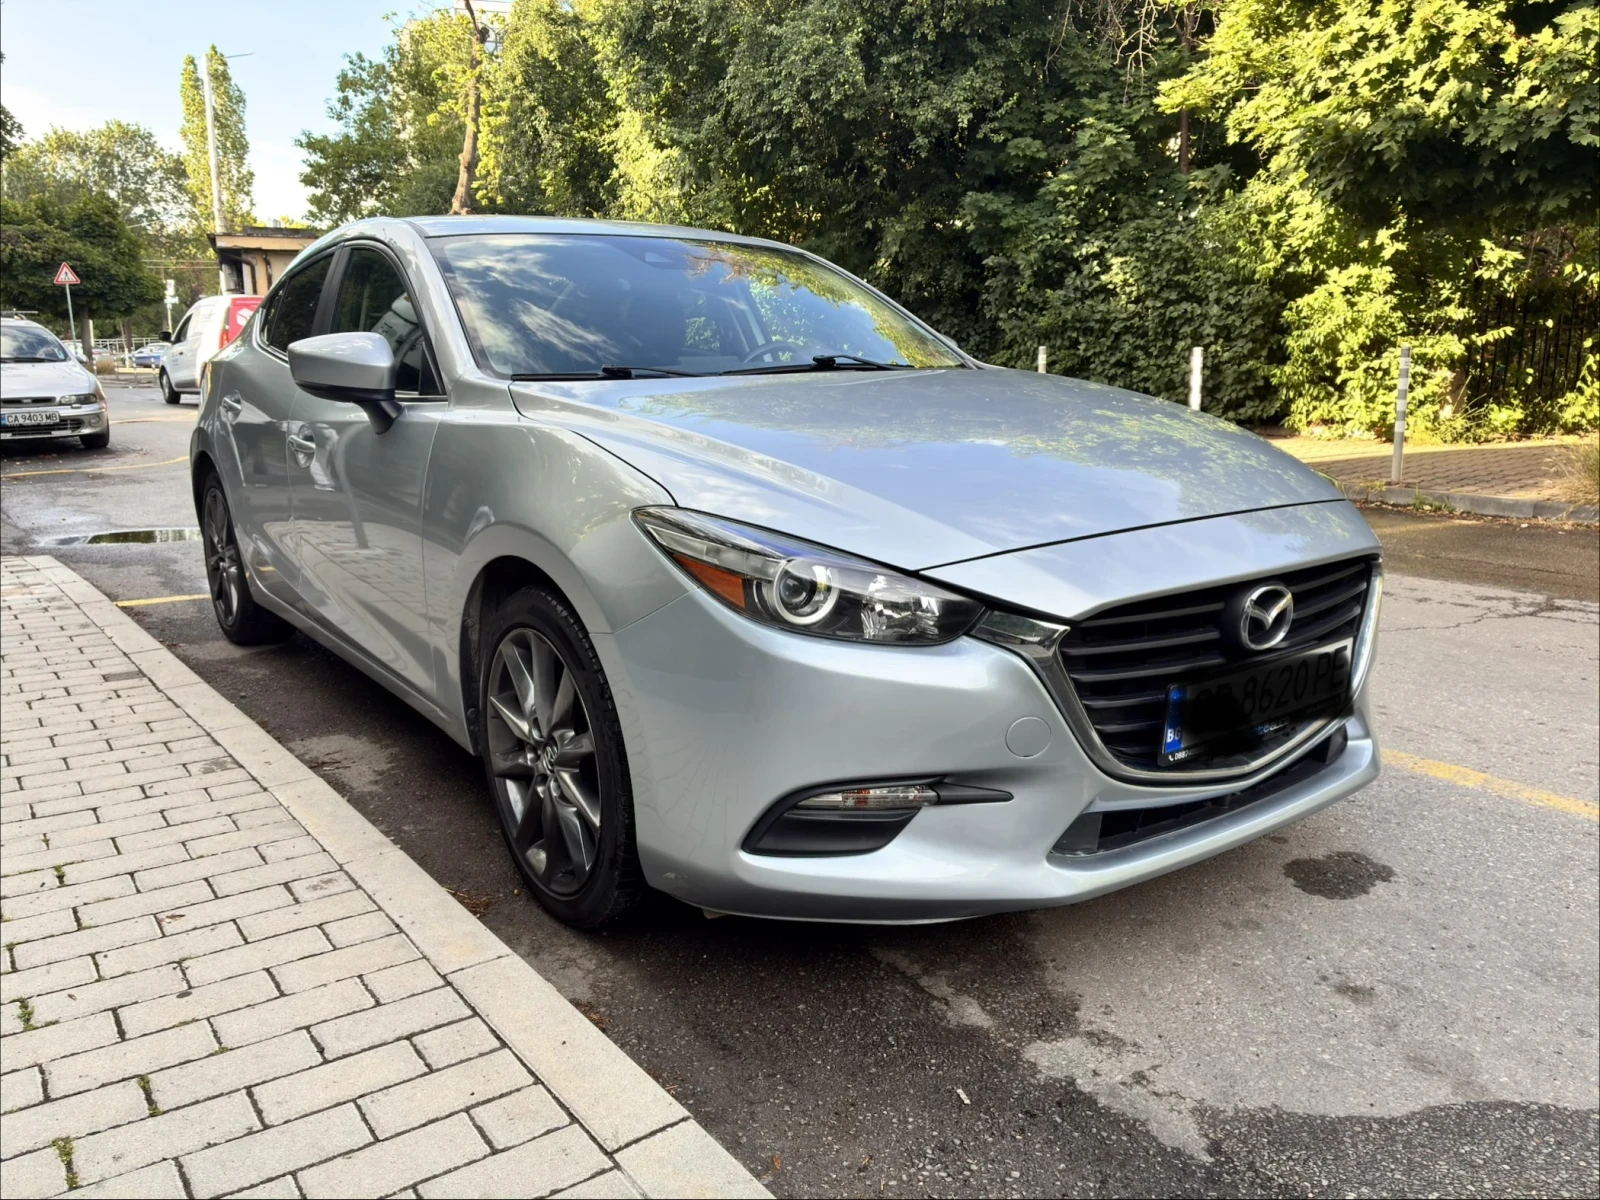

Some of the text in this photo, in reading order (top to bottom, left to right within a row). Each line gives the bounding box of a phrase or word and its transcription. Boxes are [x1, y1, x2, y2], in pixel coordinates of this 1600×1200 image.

[7, 412, 58, 424] CA 9403 MB
[1241, 660, 1308, 717] 8620
[1166, 727, 1182, 743] BG
